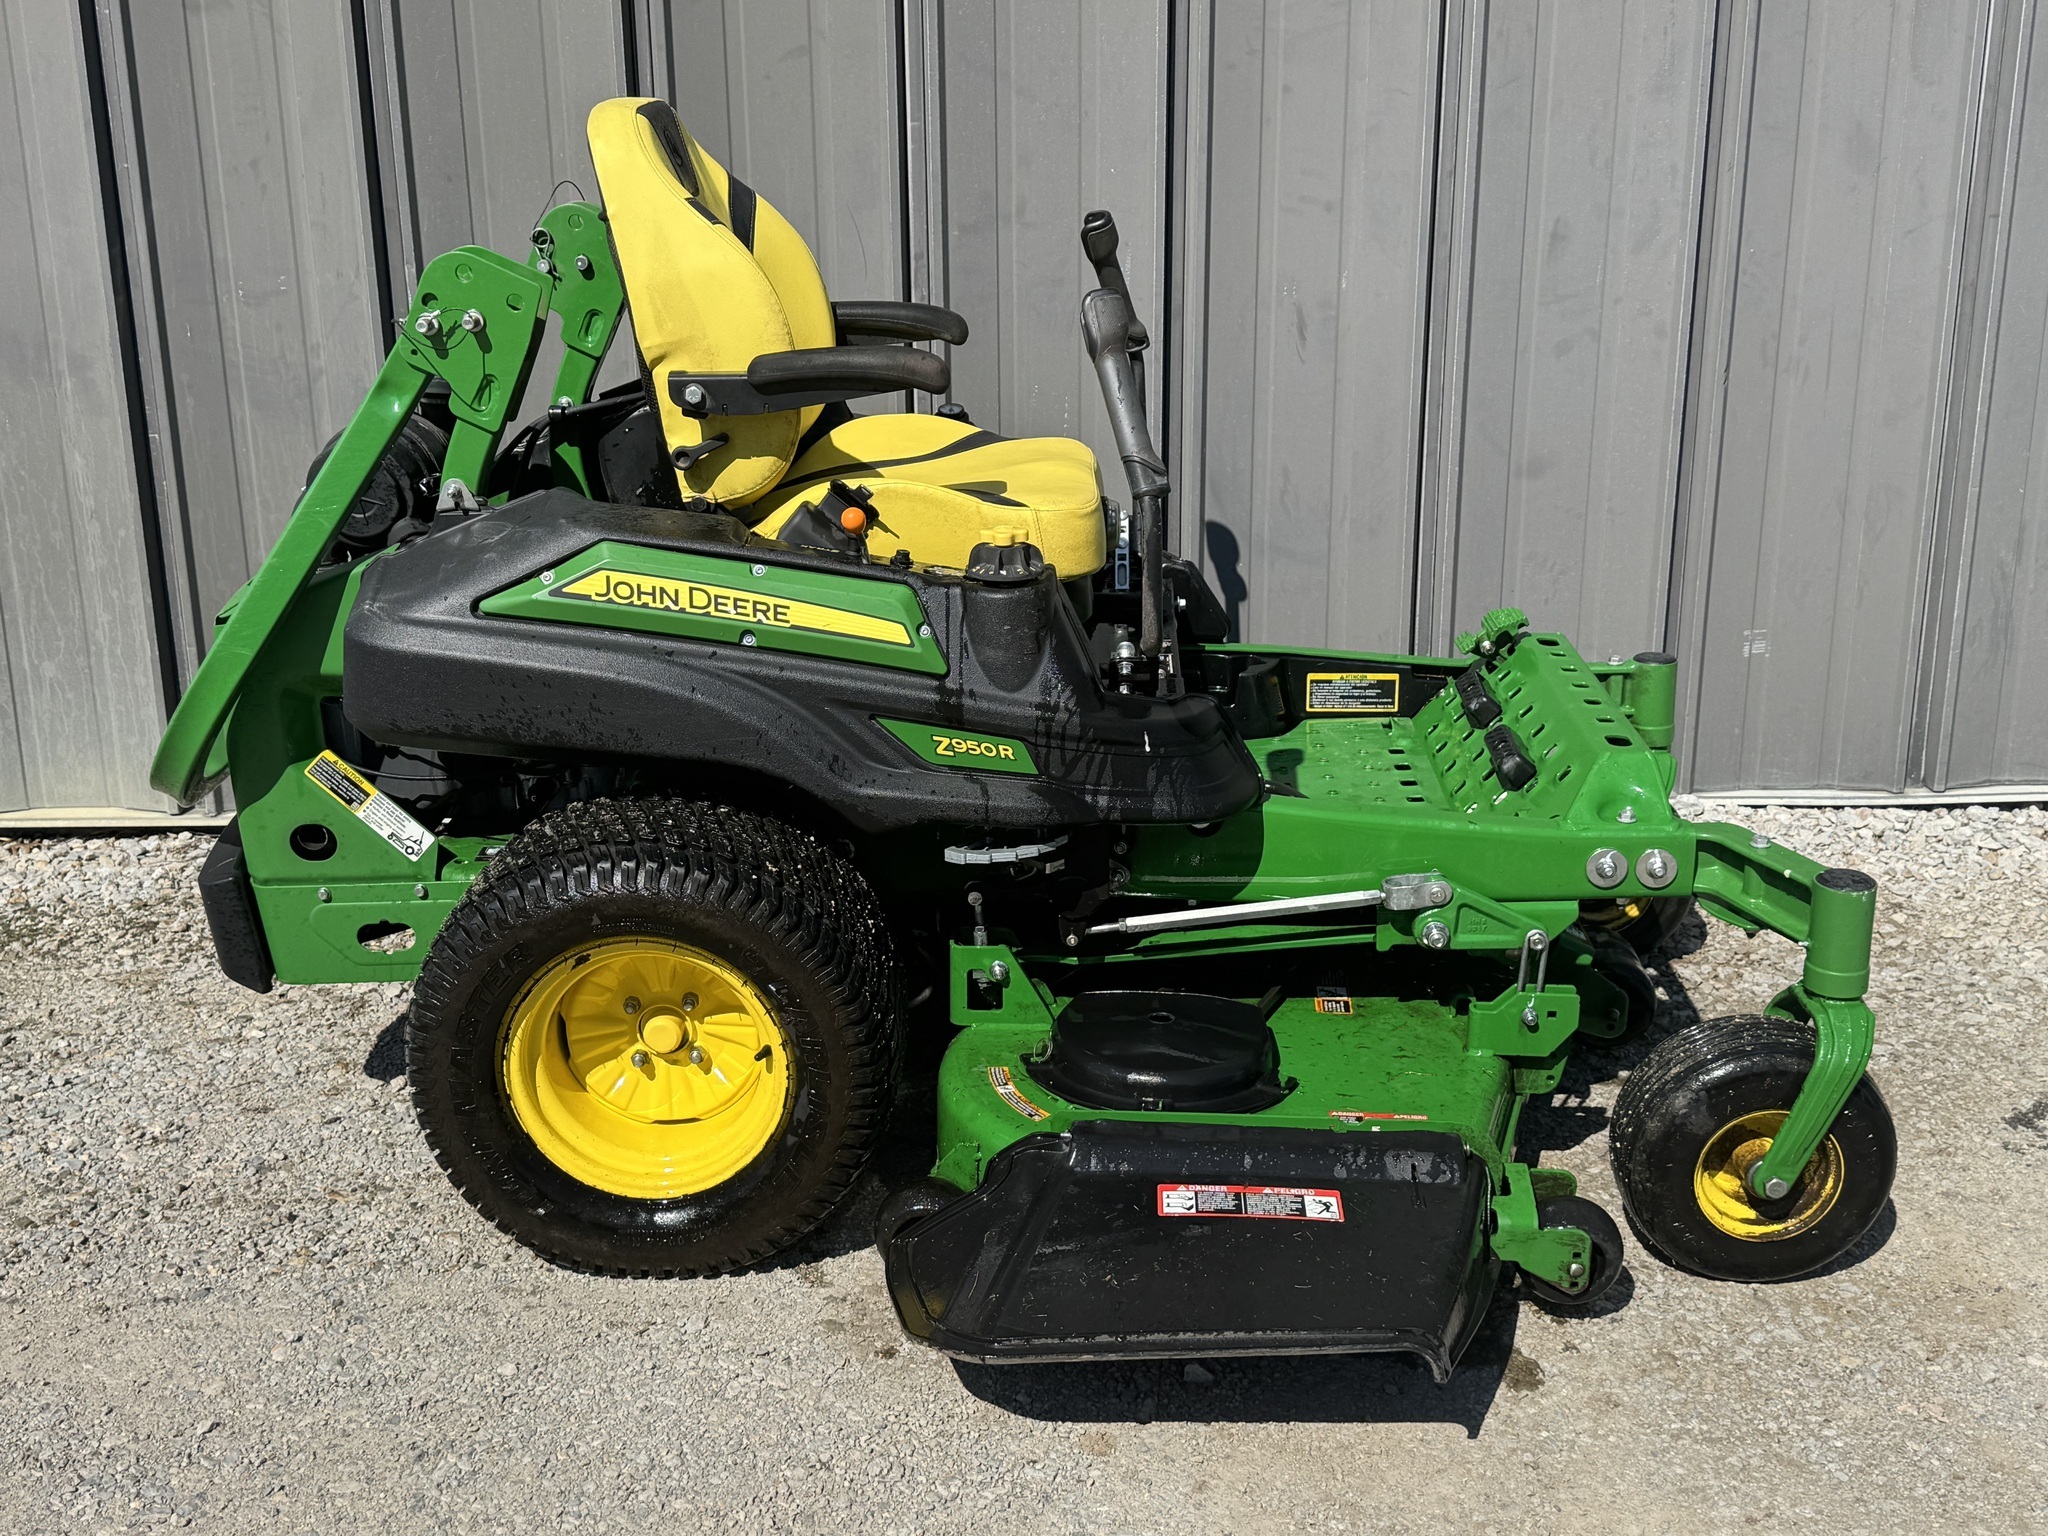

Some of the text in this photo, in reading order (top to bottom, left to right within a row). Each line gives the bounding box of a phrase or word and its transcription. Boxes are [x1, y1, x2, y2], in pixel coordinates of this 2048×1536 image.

[594, 575, 792, 624] JOHN DEERE
[931, 735, 1015, 760] Z950R
[338, 762, 364, 785] CAUTION
[1274, 1187, 1316, 1196] PELIGRO
